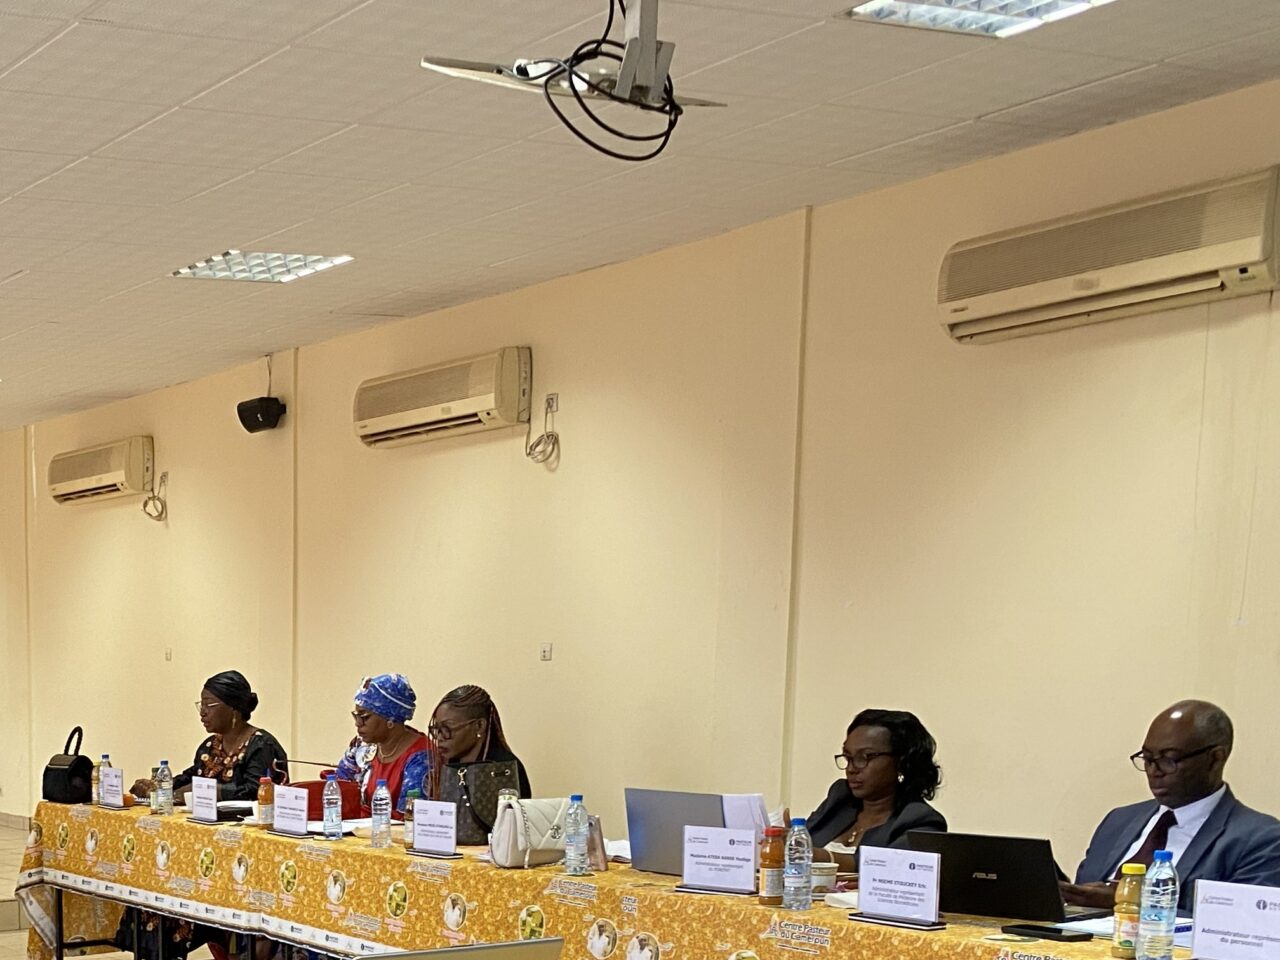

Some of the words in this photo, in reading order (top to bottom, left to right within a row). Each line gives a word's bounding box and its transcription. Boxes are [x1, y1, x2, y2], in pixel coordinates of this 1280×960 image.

[972, 872, 997, 880] ASUS
[780, 920, 803, 931] Centre
[804, 924, 830, 935] Pasteur
[1202, 928, 1250, 939] Administrateur
[791, 932, 829, 945] Cameroun
